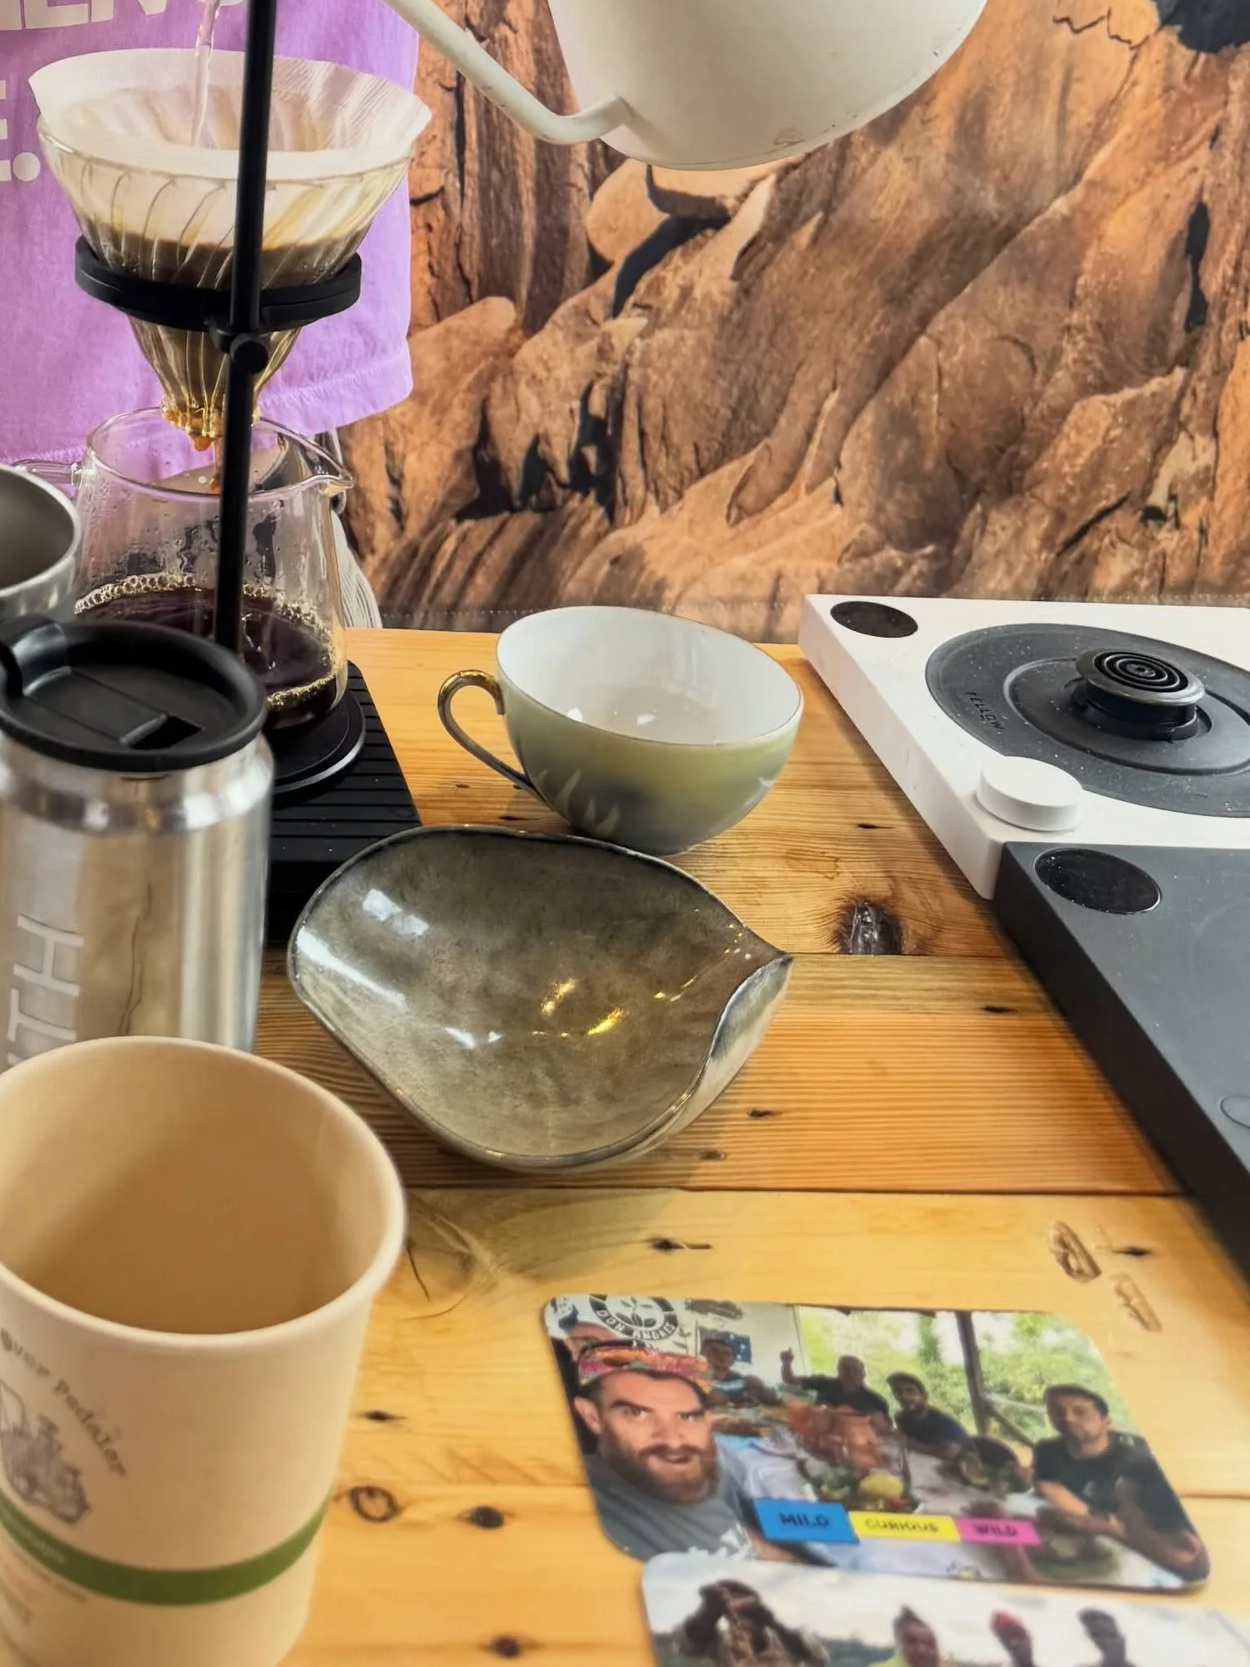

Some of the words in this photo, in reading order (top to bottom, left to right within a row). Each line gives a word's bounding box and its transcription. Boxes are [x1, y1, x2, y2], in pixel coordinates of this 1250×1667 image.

[965, 692, 1006, 730] FELLOW
[596, 1310, 626, 1332] DON
[779, 1512, 830, 1529] MILD
[865, 1516, 940, 1533] CURIOUS
[972, 1524, 1018, 1538] WILD
